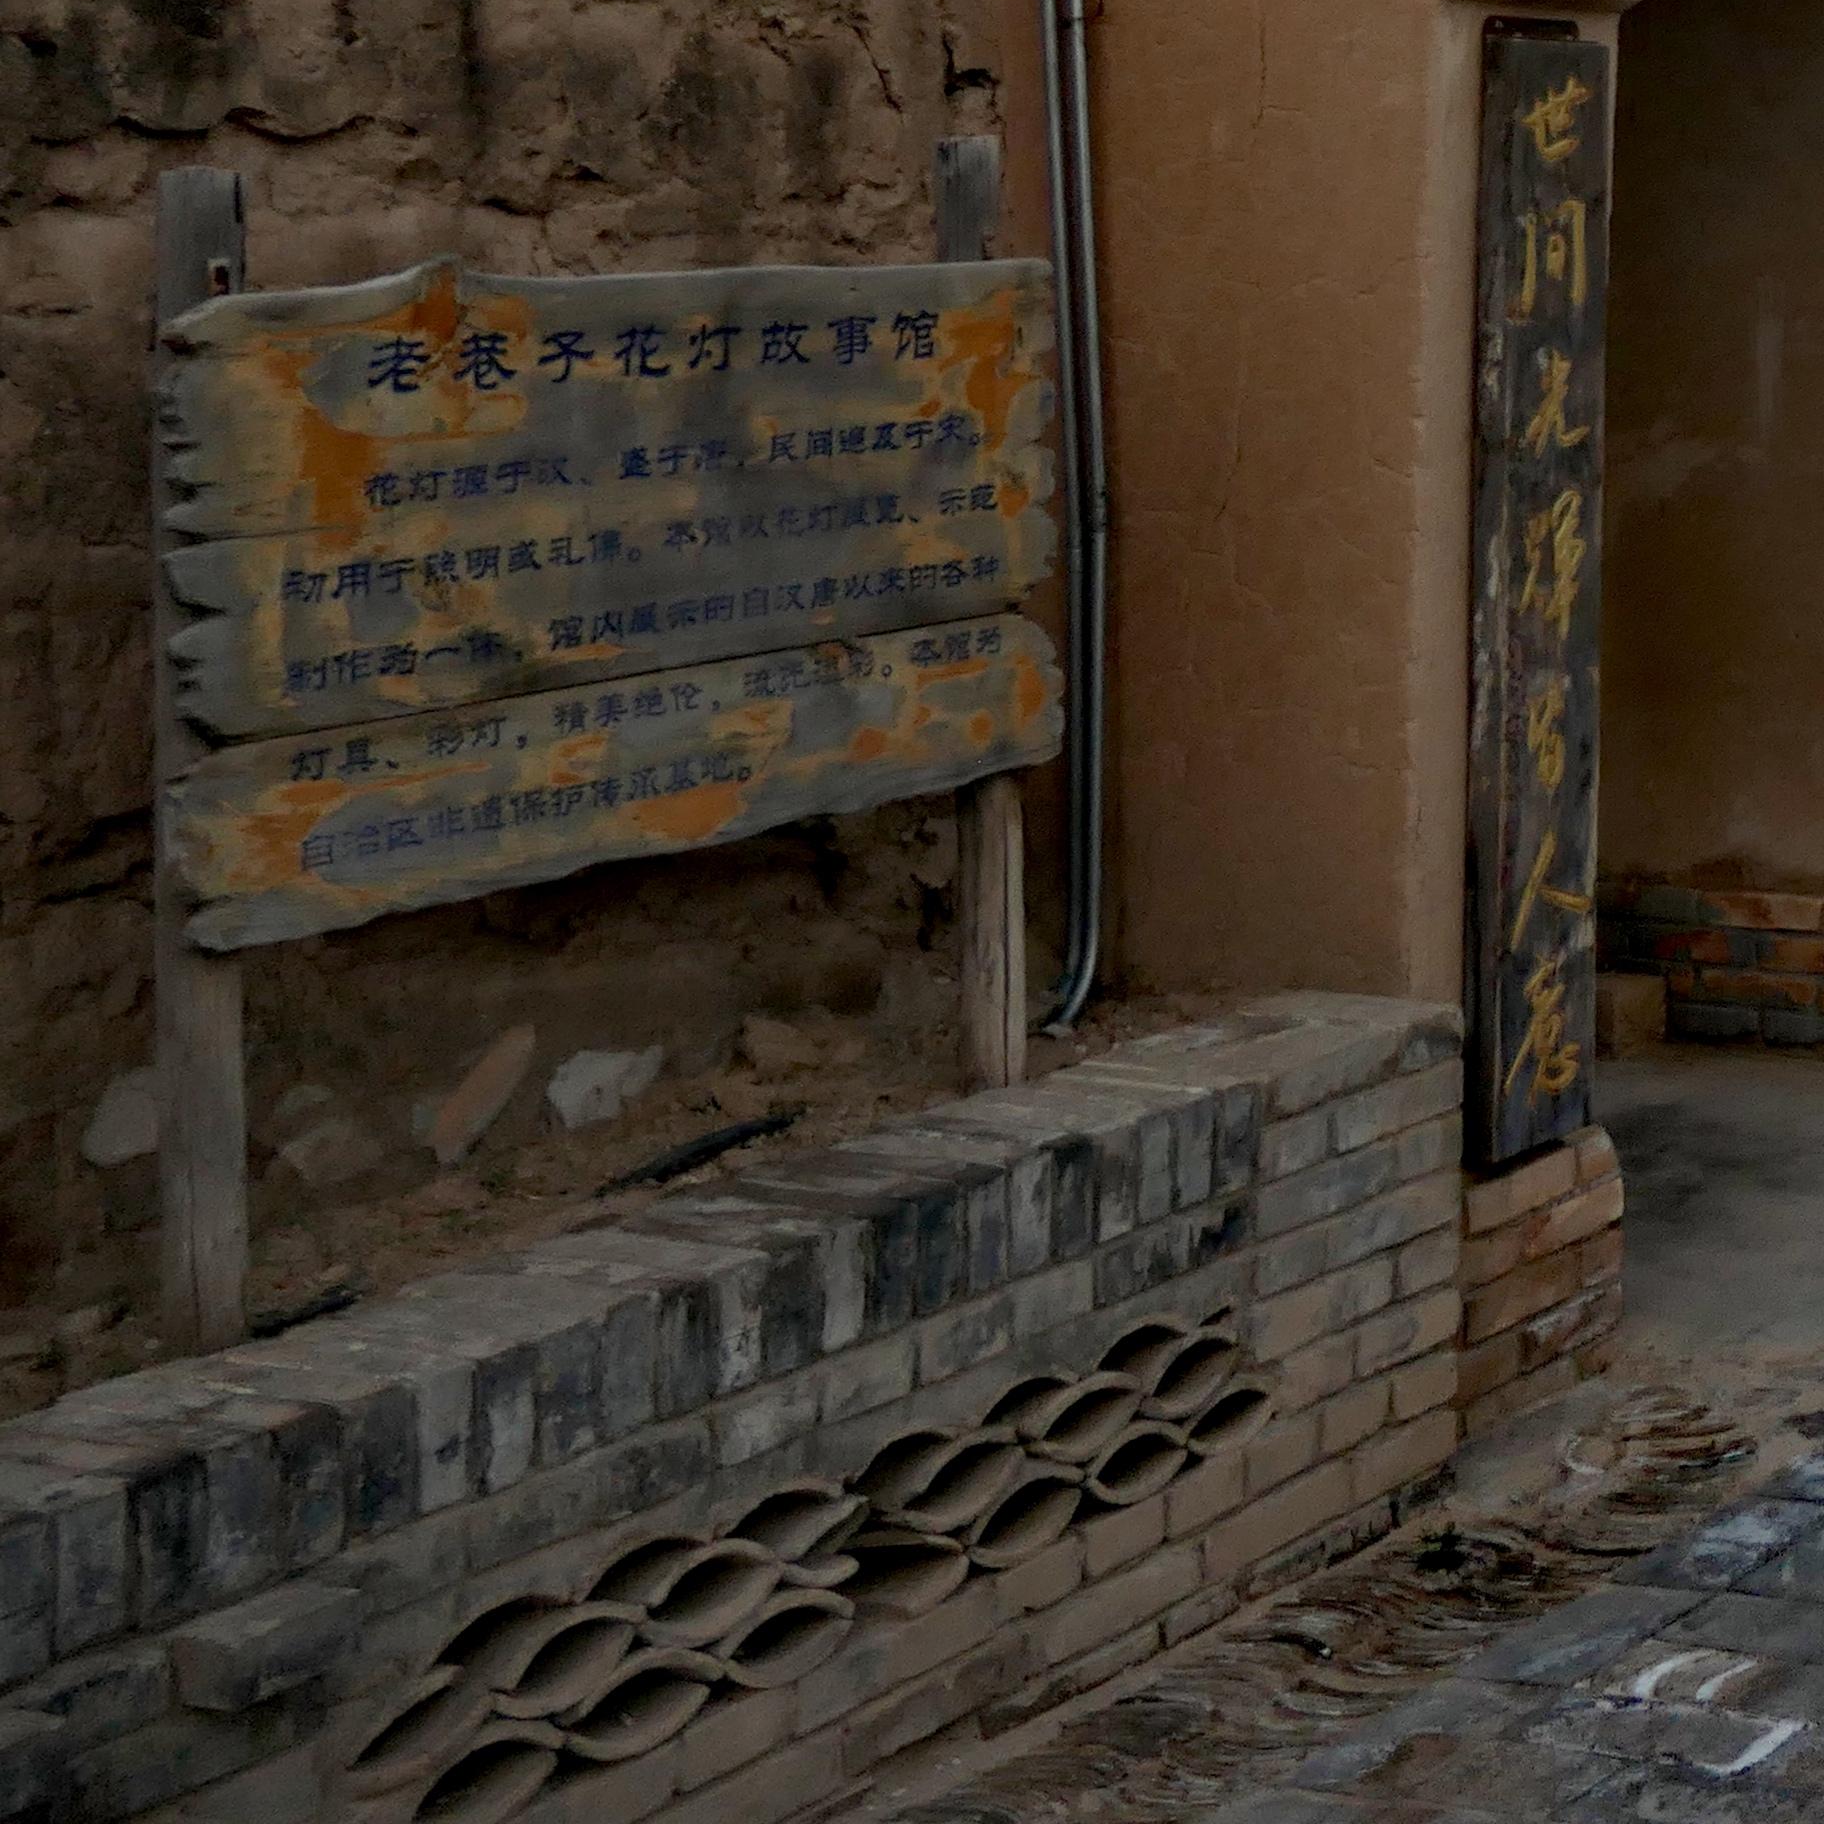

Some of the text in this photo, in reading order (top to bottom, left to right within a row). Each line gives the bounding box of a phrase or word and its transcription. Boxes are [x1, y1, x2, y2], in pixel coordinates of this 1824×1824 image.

[367, 311, 940, 393] 老巷子花灯故事馆
